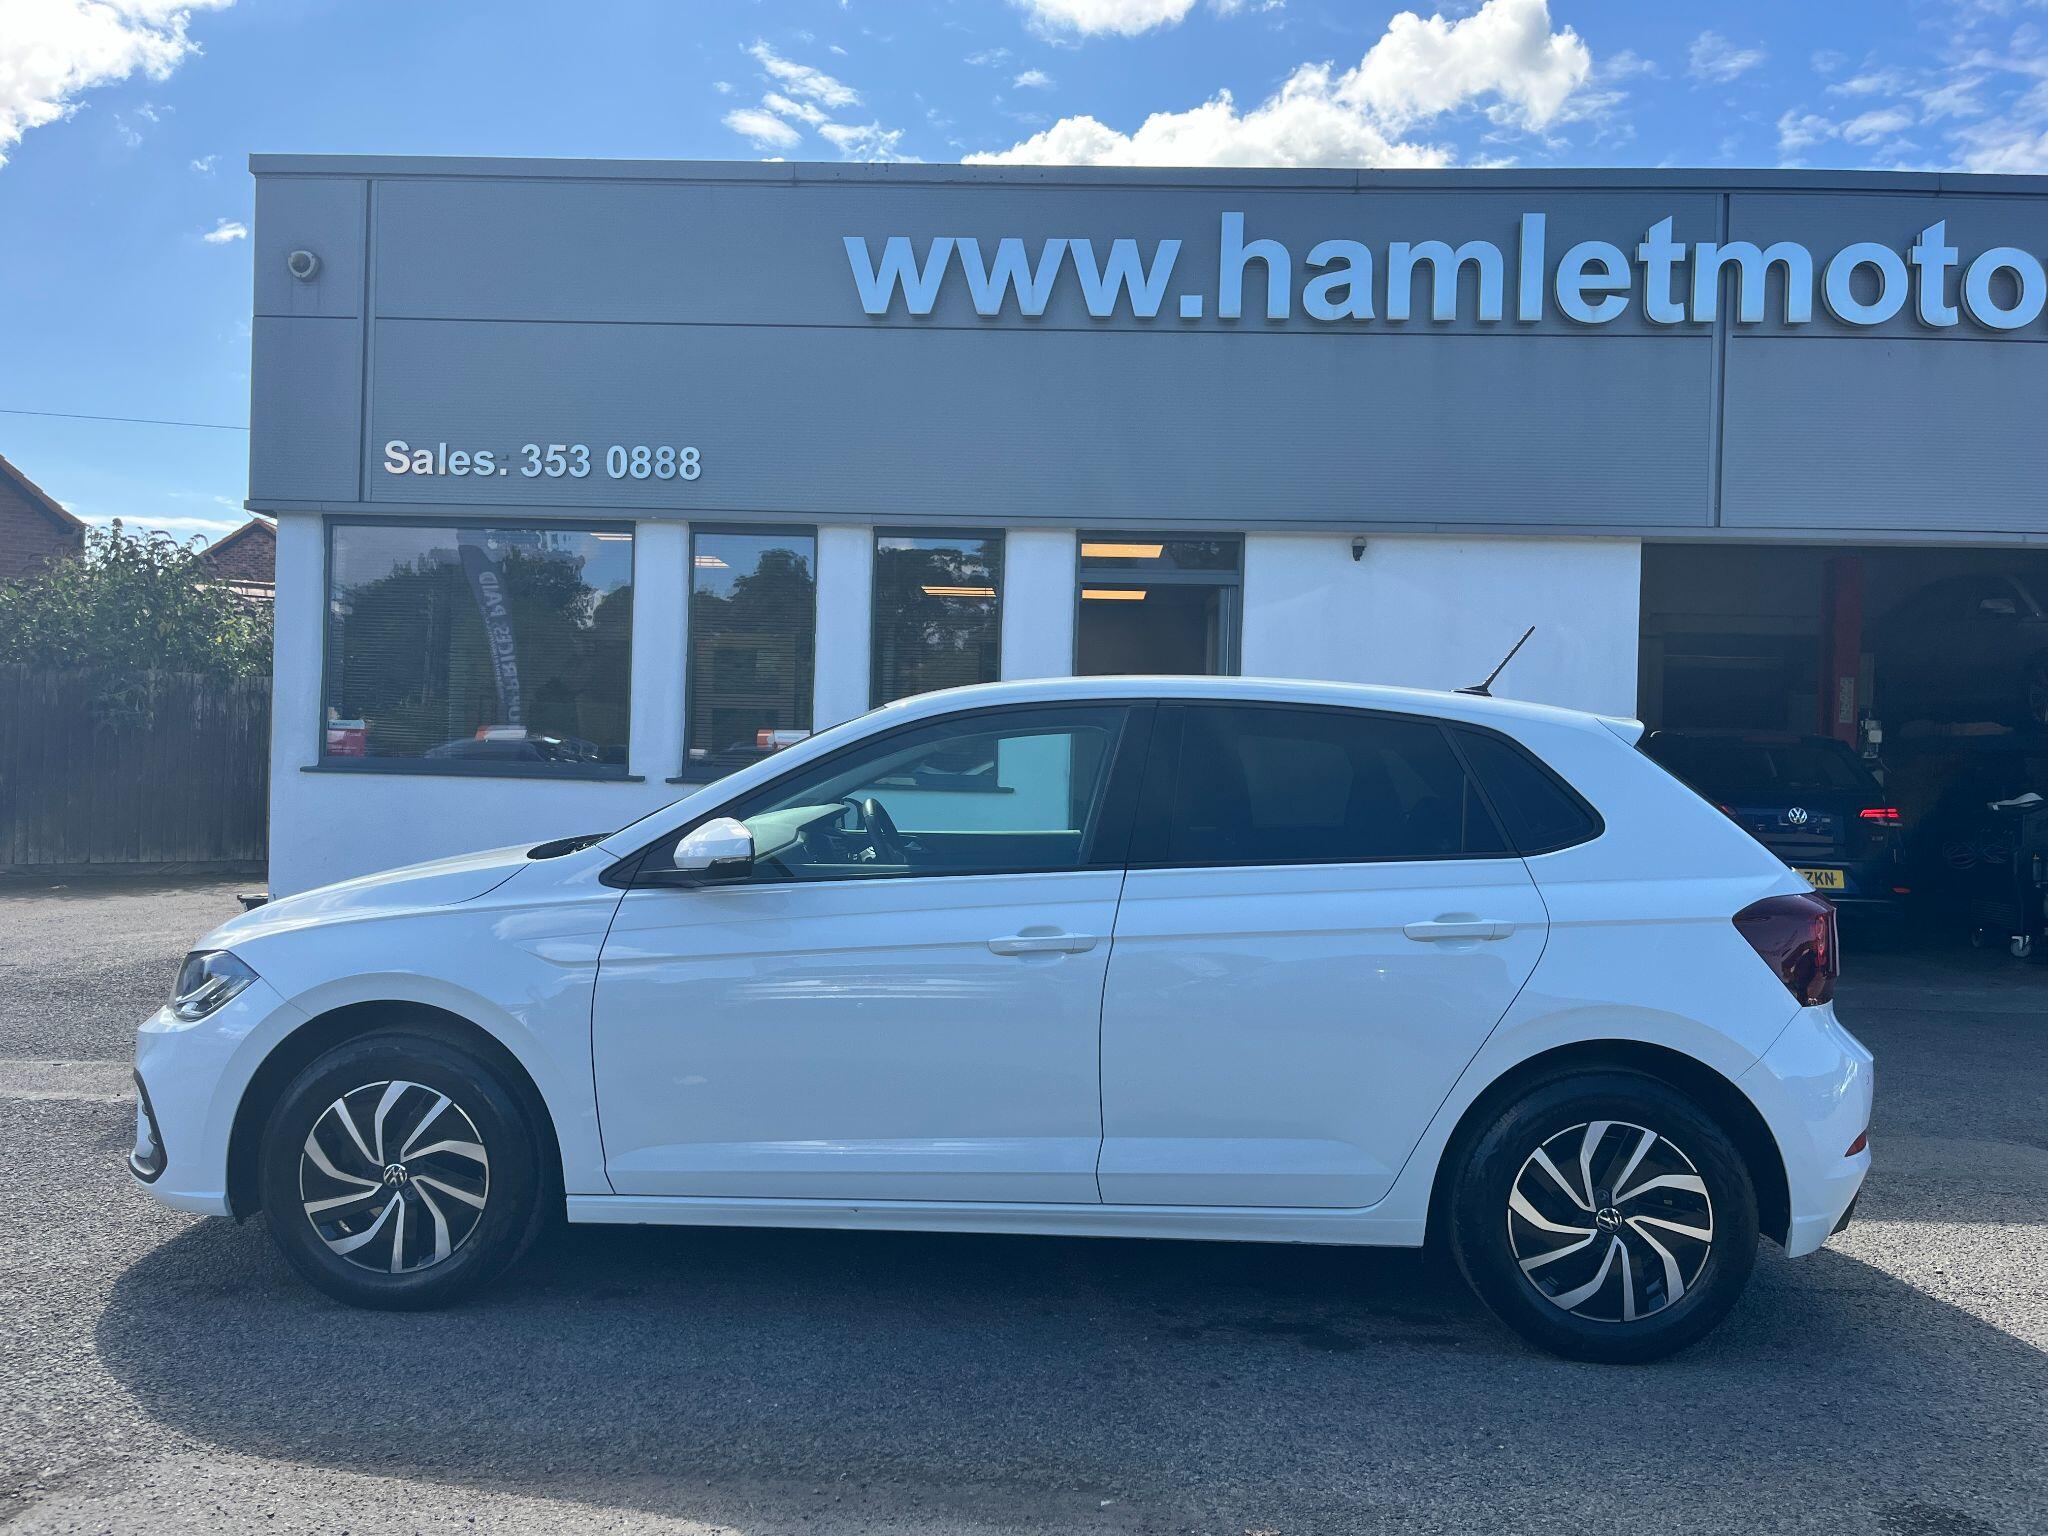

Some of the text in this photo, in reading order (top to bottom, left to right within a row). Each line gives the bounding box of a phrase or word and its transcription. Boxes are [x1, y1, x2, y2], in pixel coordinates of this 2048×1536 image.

[843, 211, 2047, 329] www.hamletmoto
[520, 444, 591, 478] 353
[606, 445, 701, 480] 0888
